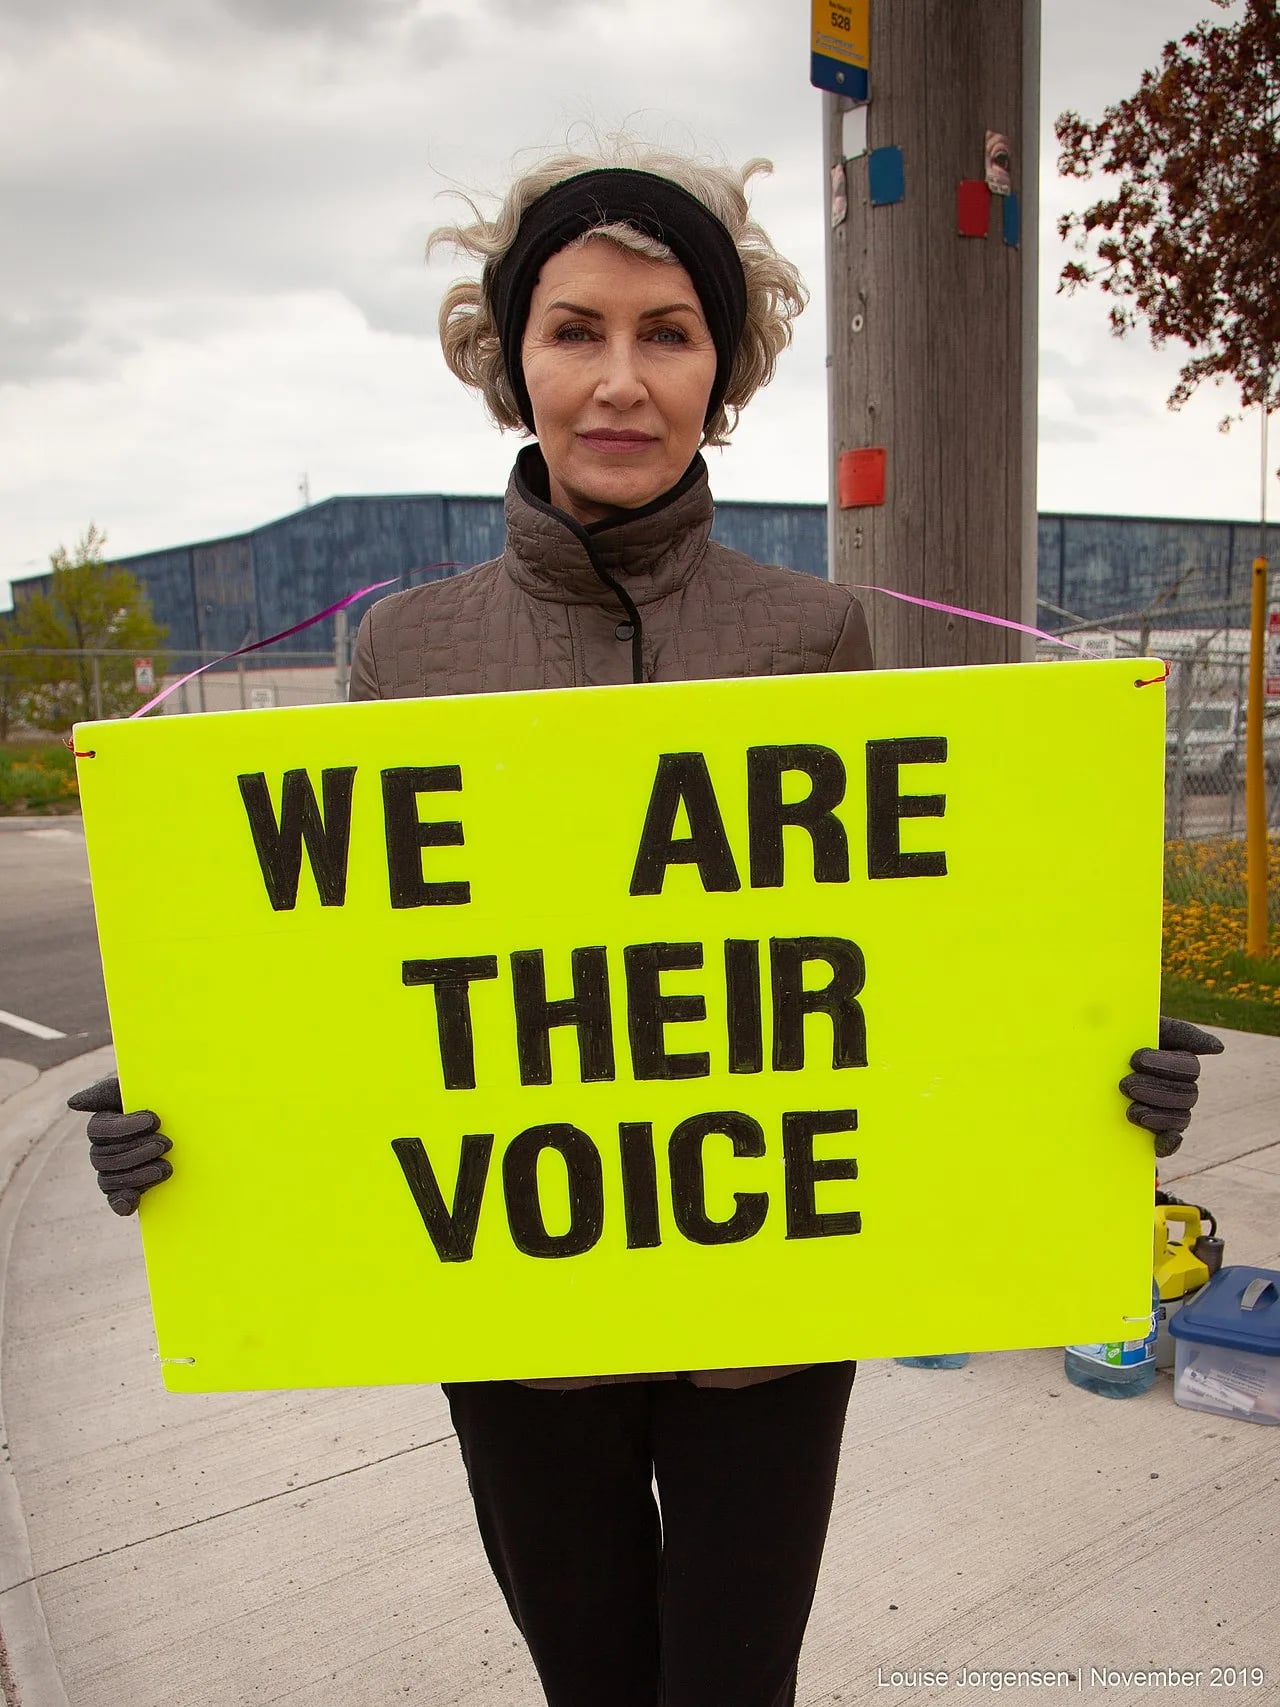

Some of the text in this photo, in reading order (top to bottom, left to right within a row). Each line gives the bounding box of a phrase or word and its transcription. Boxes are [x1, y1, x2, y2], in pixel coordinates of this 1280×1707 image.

[831, 12, 851, 32] 528
[237, 736, 948, 911] WE ARE
[402, 937, 868, 1090] THEIR
[391, 1109, 862, 1262] VOICE
